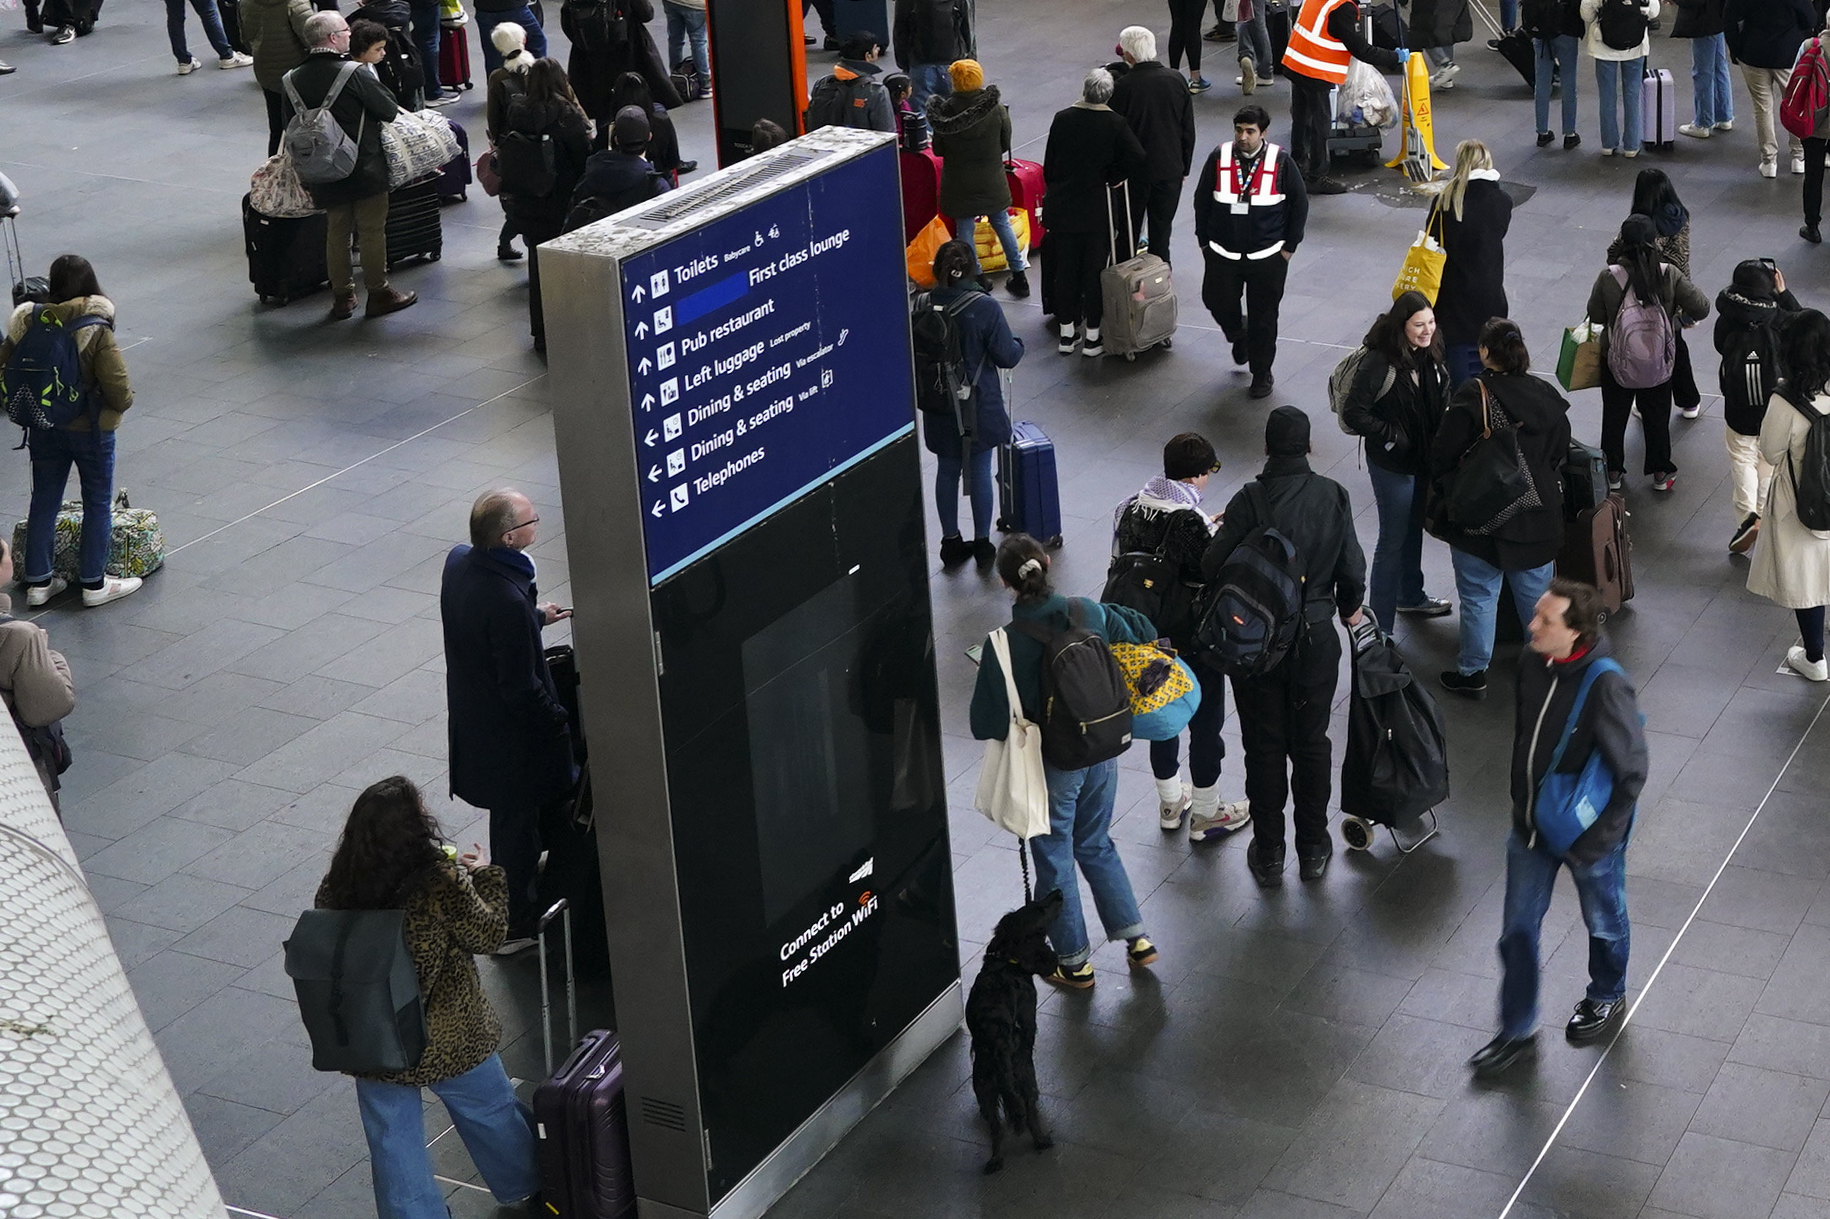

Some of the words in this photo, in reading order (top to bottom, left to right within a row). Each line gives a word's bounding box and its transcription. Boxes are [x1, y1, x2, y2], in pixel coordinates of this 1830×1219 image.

[674, 254, 718, 285] Toilets
[724, 245, 751, 262] Babycare
[749, 263, 776, 287] First
[779, 248, 807, 272] class
[810, 228, 850, 257] lounge
[682, 332, 707, 356] Pub
[710, 299, 775, 342] restaurant
[685, 367, 712, 391] Left
[715, 341, 765, 376] luggage
[770, 335, 784, 347] Lost
[785, 321, 811, 341] property
[688, 394, 731, 426] Dining
[734, 385, 744, 402] &
[747, 362, 791, 395] seating
[796, 357, 806, 368] Via
[807, 344, 833, 363] escalator
[691, 429, 733, 461] Dining
[737, 420, 747, 436] &
[750, 396, 793, 429] seating
[799, 391, 808, 401] Via
[693, 447, 765, 495] Telephones
[780, 913, 829, 961] Connect
[830, 902, 844, 920] to
[782, 959, 808, 988] Free
[810, 921, 851, 964] Station
[852, 895, 878, 926] WiFi
